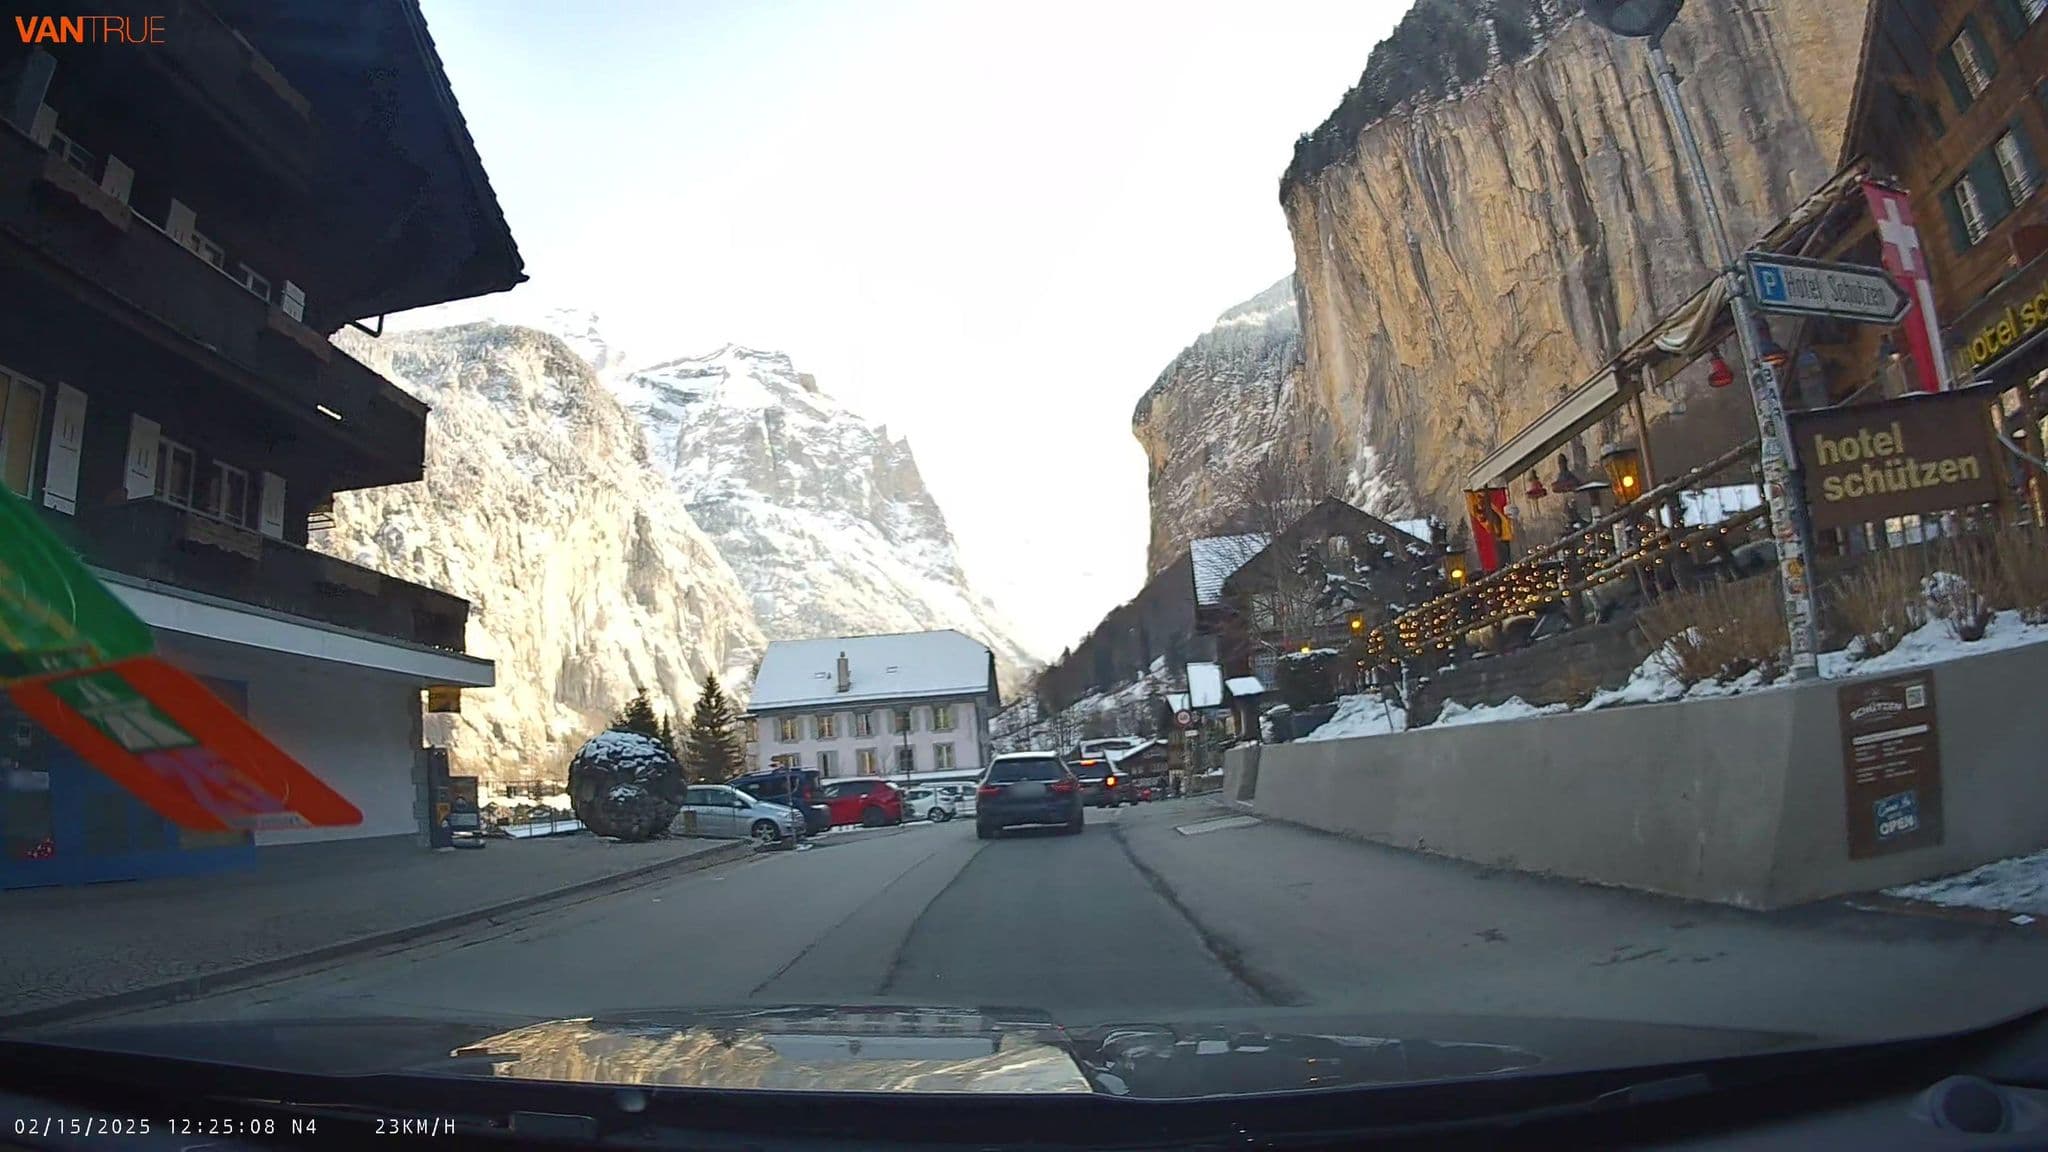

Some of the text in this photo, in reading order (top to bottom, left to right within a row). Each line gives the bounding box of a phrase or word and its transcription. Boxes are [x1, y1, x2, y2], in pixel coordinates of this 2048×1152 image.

[1784, 271, 1823, 301] Hotel
[1814, 421, 1904, 466] hotel
[1823, 455, 1979, 501] schützen
[1879, 815, 1915, 836] OPEN
